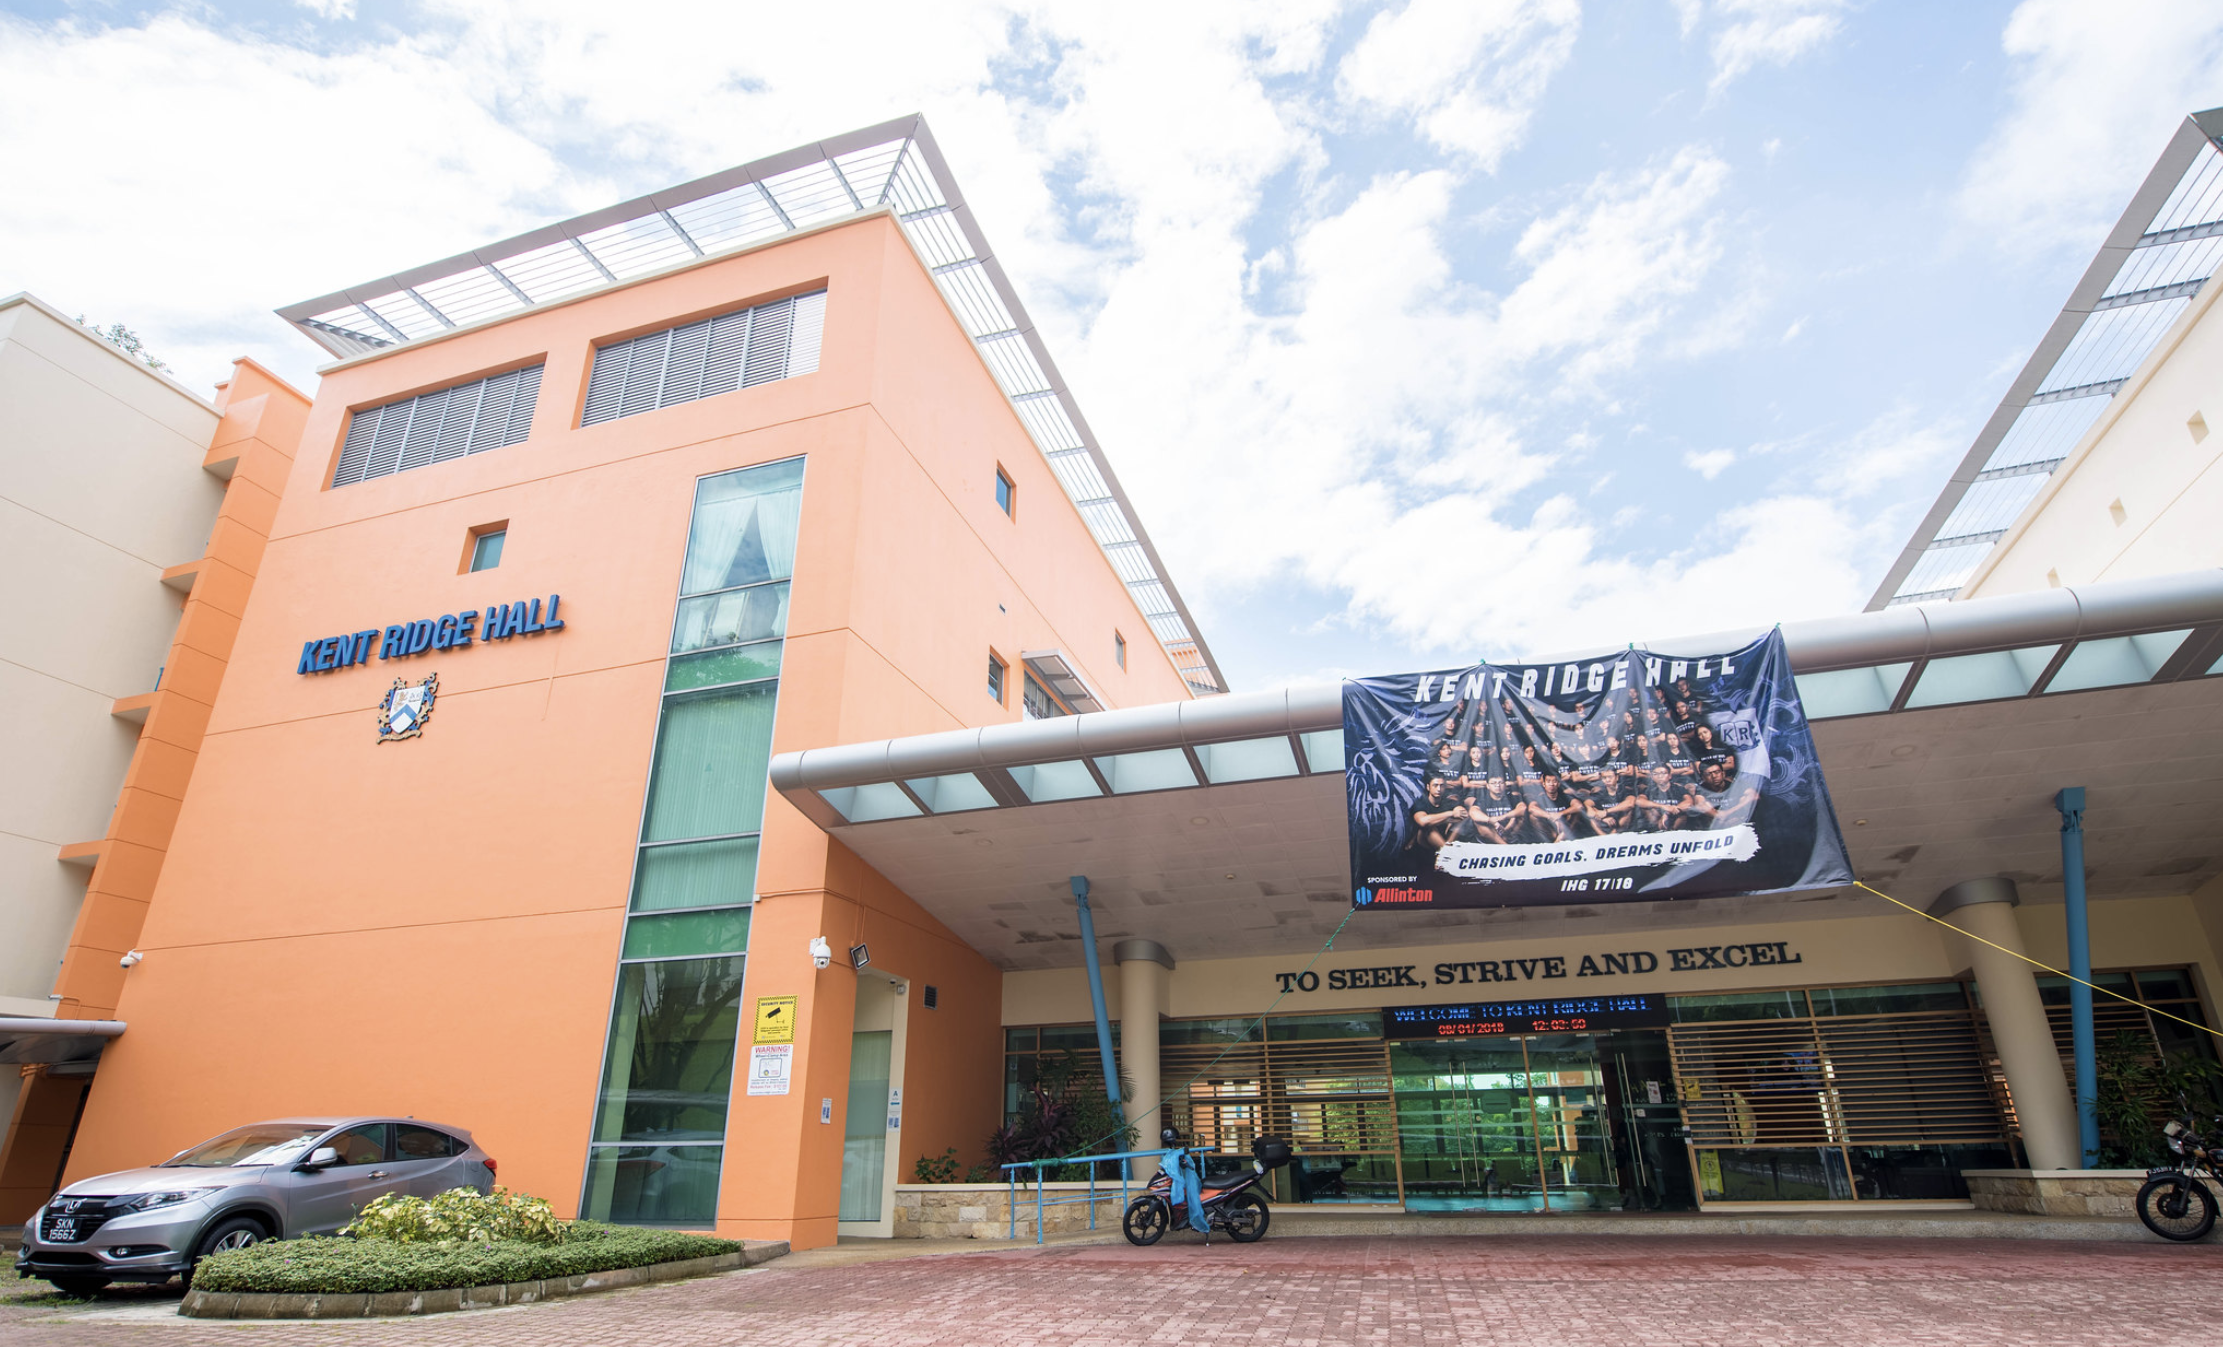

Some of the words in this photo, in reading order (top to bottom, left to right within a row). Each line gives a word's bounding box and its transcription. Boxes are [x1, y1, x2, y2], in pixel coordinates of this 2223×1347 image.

[297, 629, 380, 675] KENT
[378, 610, 478, 660] RIDGE
[481, 594, 565, 641] HALL
[1415, 672, 1508, 703] KENT
[1520, 659, 1629, 699] RIDGE
[1645, 656, 1735, 687] HALL
[1458, 855, 1526, 870] CHASING
[1533, 850, 1587, 866] GOALS.
[1595, 842, 1663, 860] DREAMS
[1670, 834, 1734, 854] UNFOLD
[1367, 875, 1407, 884] SPONSORED
[1560, 879, 1588, 892] IHG
[1374, 887, 1433, 903] Allinton
[1276, 971, 1320, 993] TO
[1328, 964, 1428, 991] SEEK,
[1434, 956, 1566, 986] STRIVE
[1576, 951, 1659, 977] AND
[1667, 942, 1802, 972] EXCEL
[755, 1045, 791, 1054] WARNING!
[56, 1218, 75, 1229] SKN
[49, 1229, 77, 1240] 1566Z
